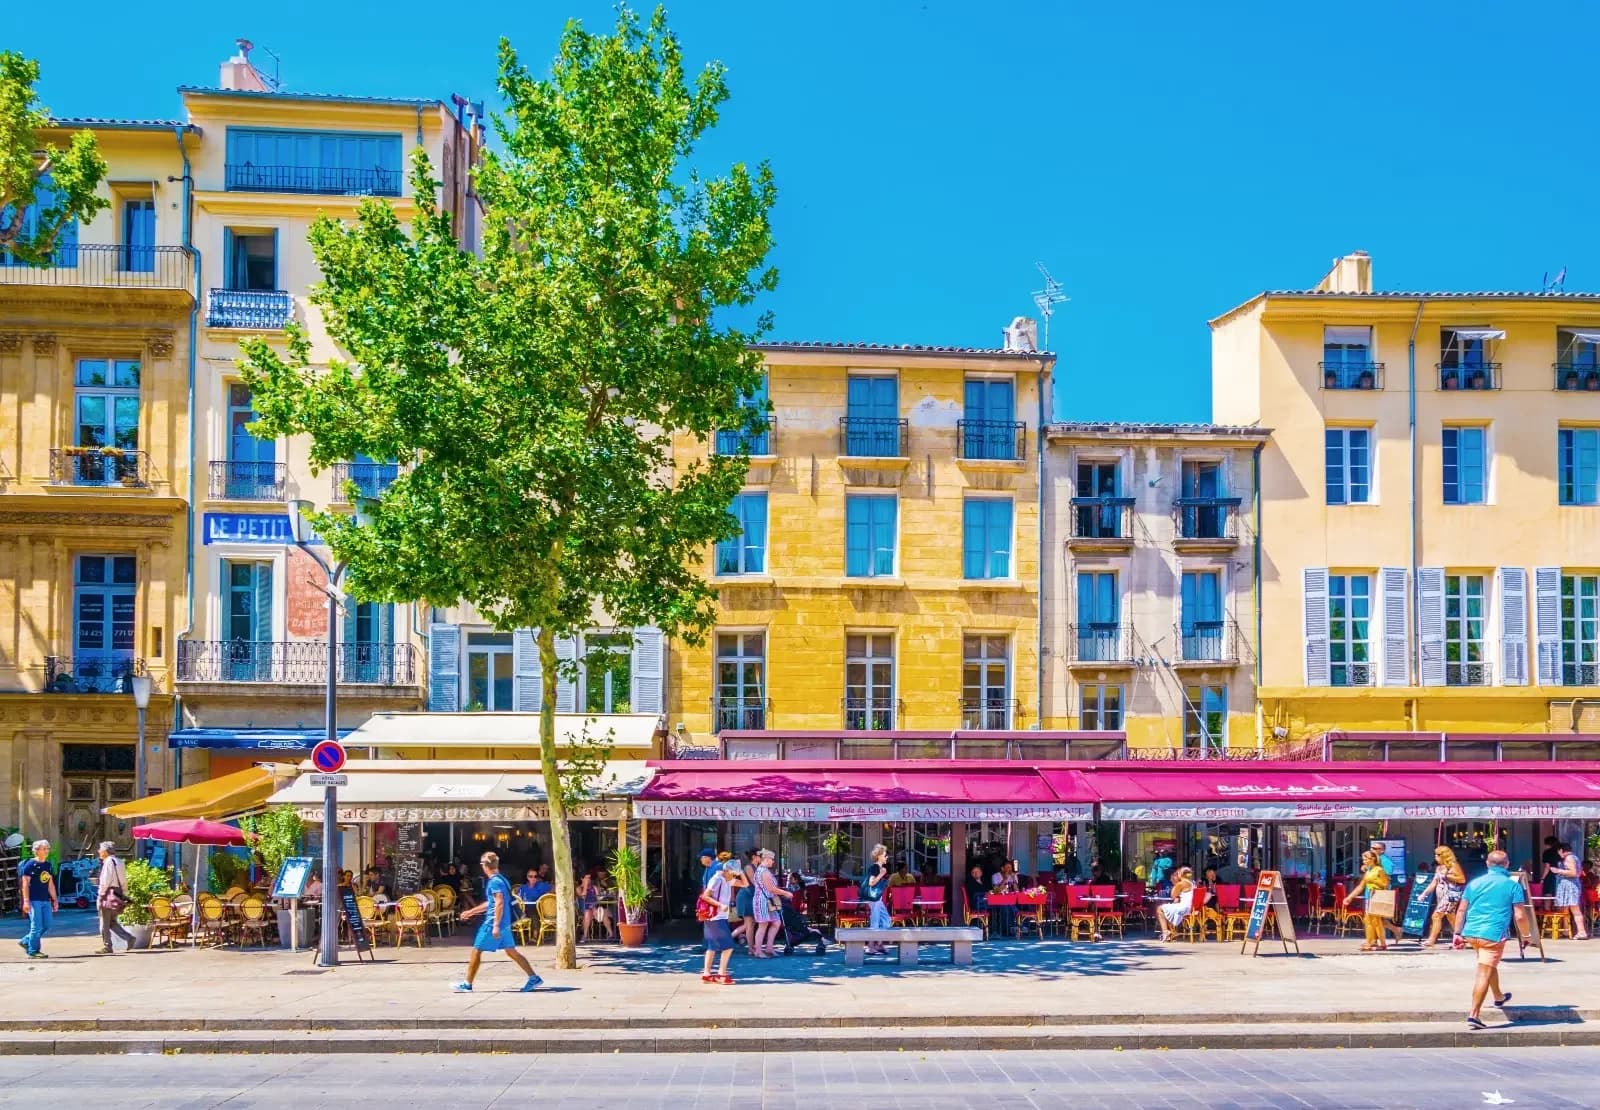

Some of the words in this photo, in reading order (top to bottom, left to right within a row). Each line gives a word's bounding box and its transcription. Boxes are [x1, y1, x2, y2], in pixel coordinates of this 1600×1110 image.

[210, 517, 230, 539] LE
[238, 518, 288, 539] PETIT
[341, 806, 369, 819] afé
[383, 805, 510, 820] RESTAURANT
[571, 804, 608, 818] Café
[641, 805, 726, 817] CHAMBRES
[730, 807, 744, 817] de
[749, 807, 816, 818] CHARME
[902, 807, 979, 819] BRASSERIE
[984, 807, 1084, 818] RESTAURANT
[1150, 807, 1191, 817] Service
[1196, 807, 1245, 818] Continu
[1403, 805, 1465, 817] GLACIER
